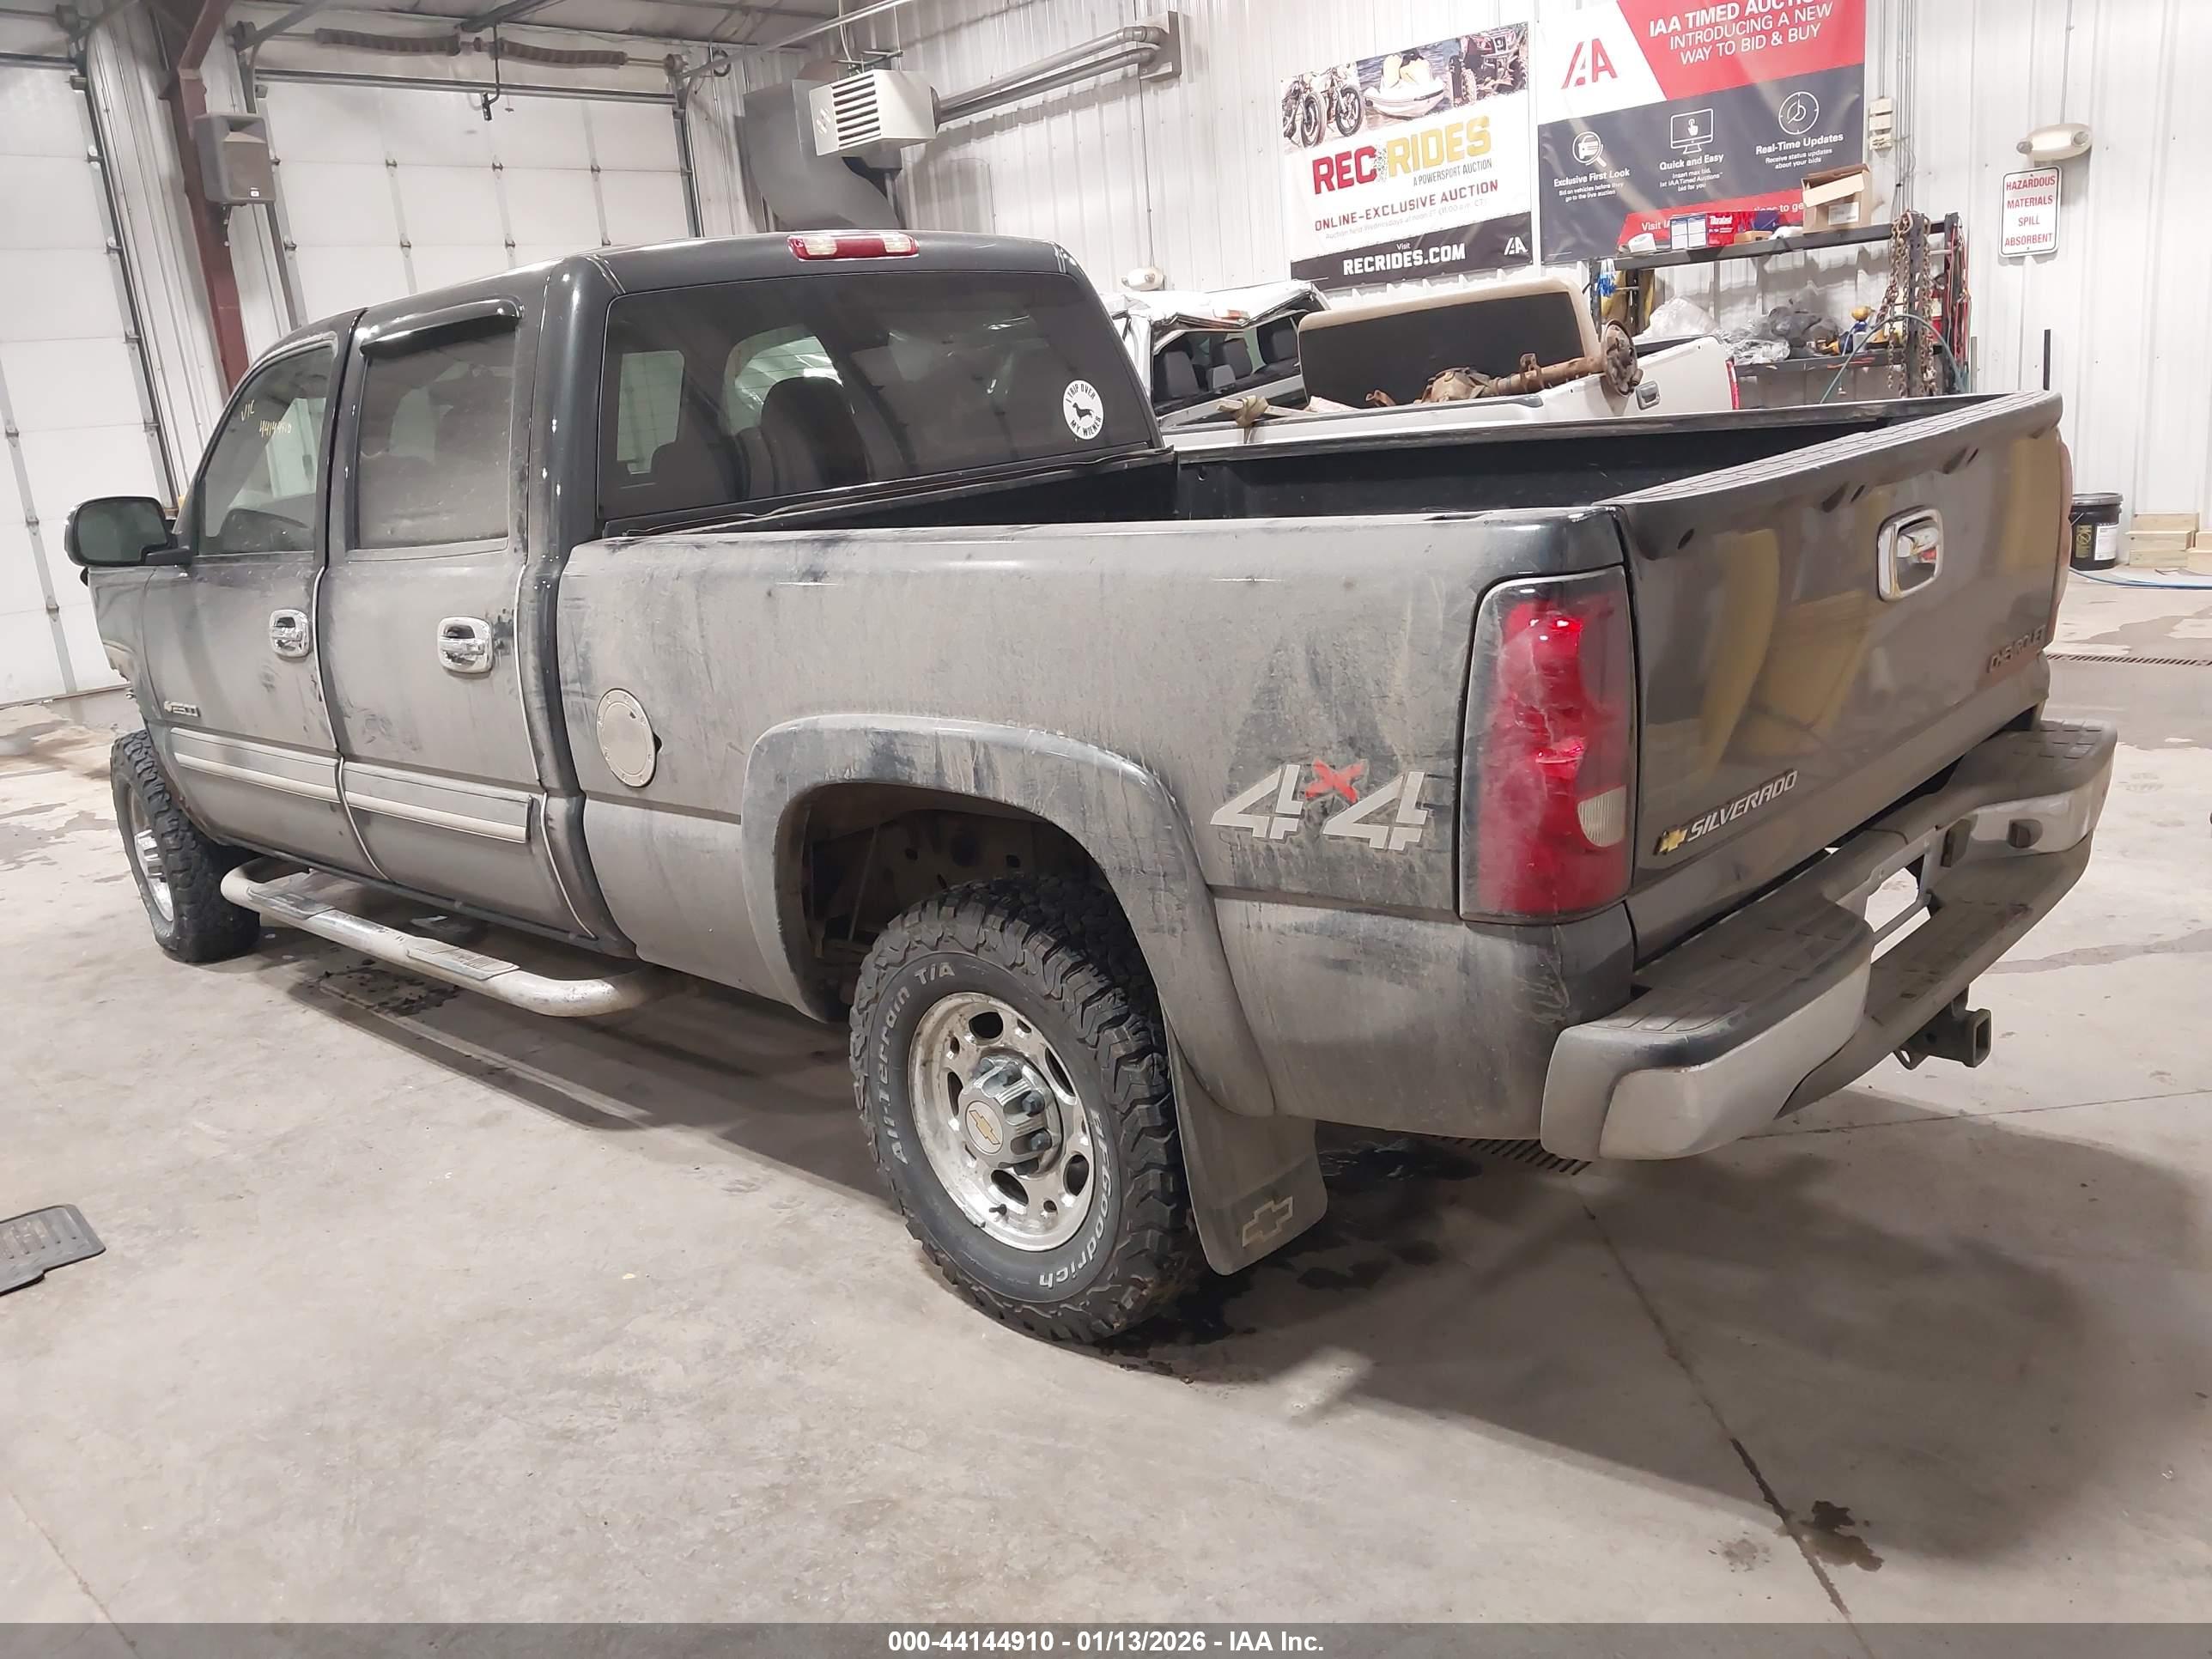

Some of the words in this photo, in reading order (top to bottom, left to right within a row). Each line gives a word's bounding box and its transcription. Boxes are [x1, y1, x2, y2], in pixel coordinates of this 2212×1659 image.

[1650, 15, 1681, 37] IAA
[1685, 3, 1740, 29] TIMED
[1670, 15, 1772, 50] INTRODUCING
[1778, 14, 1790, 27] A
[1794, 2, 1833, 24] NEW
[1680, 46, 1713, 65] WAY
[1717, 40, 1736, 58] TO
[1741, 34, 1766, 52] BID
[1771, 31, 1783, 46] &
[1788, 22, 1821, 43] BUY
[1755, 140, 1801, 155] Real-Time
[1802, 134, 1844, 147] Updates
[1312, 145, 1377, 195] REC
[1386, 116, 1492, 178] RIDES
[1659, 159, 1685, 170] Quick
[1686, 155, 1703, 167] and
[1704, 154, 1724, 164] Easy
[1765, 155, 1788, 164] Receive
[1788, 151, 1807, 160] status
[1808, 149, 1832, 157] updates
[1413, 176, 1418, 186] A
[1419, 166, 1461, 185] POWERSPORT
[1462, 158, 1492, 175] AUCTION
[1553, 175, 1588, 187] Exclusive
[1589, 172, 1607, 182] First
[1609, 167, 1630, 179] Look
[1672, 170, 1688, 179] Insert
[1574, 185, 1595, 193] vehicles
[2006, 175, 2056, 191] HAZARDOUS
[1315, 194, 1436, 232] ONLINE-EXCLUSIVE
[1441, 179, 1498, 204] AUCTION
[2007, 195, 2053, 209] MATERIALS
[1641, 220, 1661, 231] Visit
[2018, 215, 2040, 227] SPILL
[1396, 241, 1411, 251] Visit
[2004, 233, 2053, 246] ABSORBENT
[1343, 243, 1466, 276] RECRIDES.COM
[1067, 384, 1079, 398] TRIP
[1081, 384, 1096, 399] OVER
[1070, 420, 1080, 433] MY
[1083, 416, 1102, 437] WIENER
[1687, 770, 1798, 842] SILVERADO
[915, 962, 955, 985] T/A
